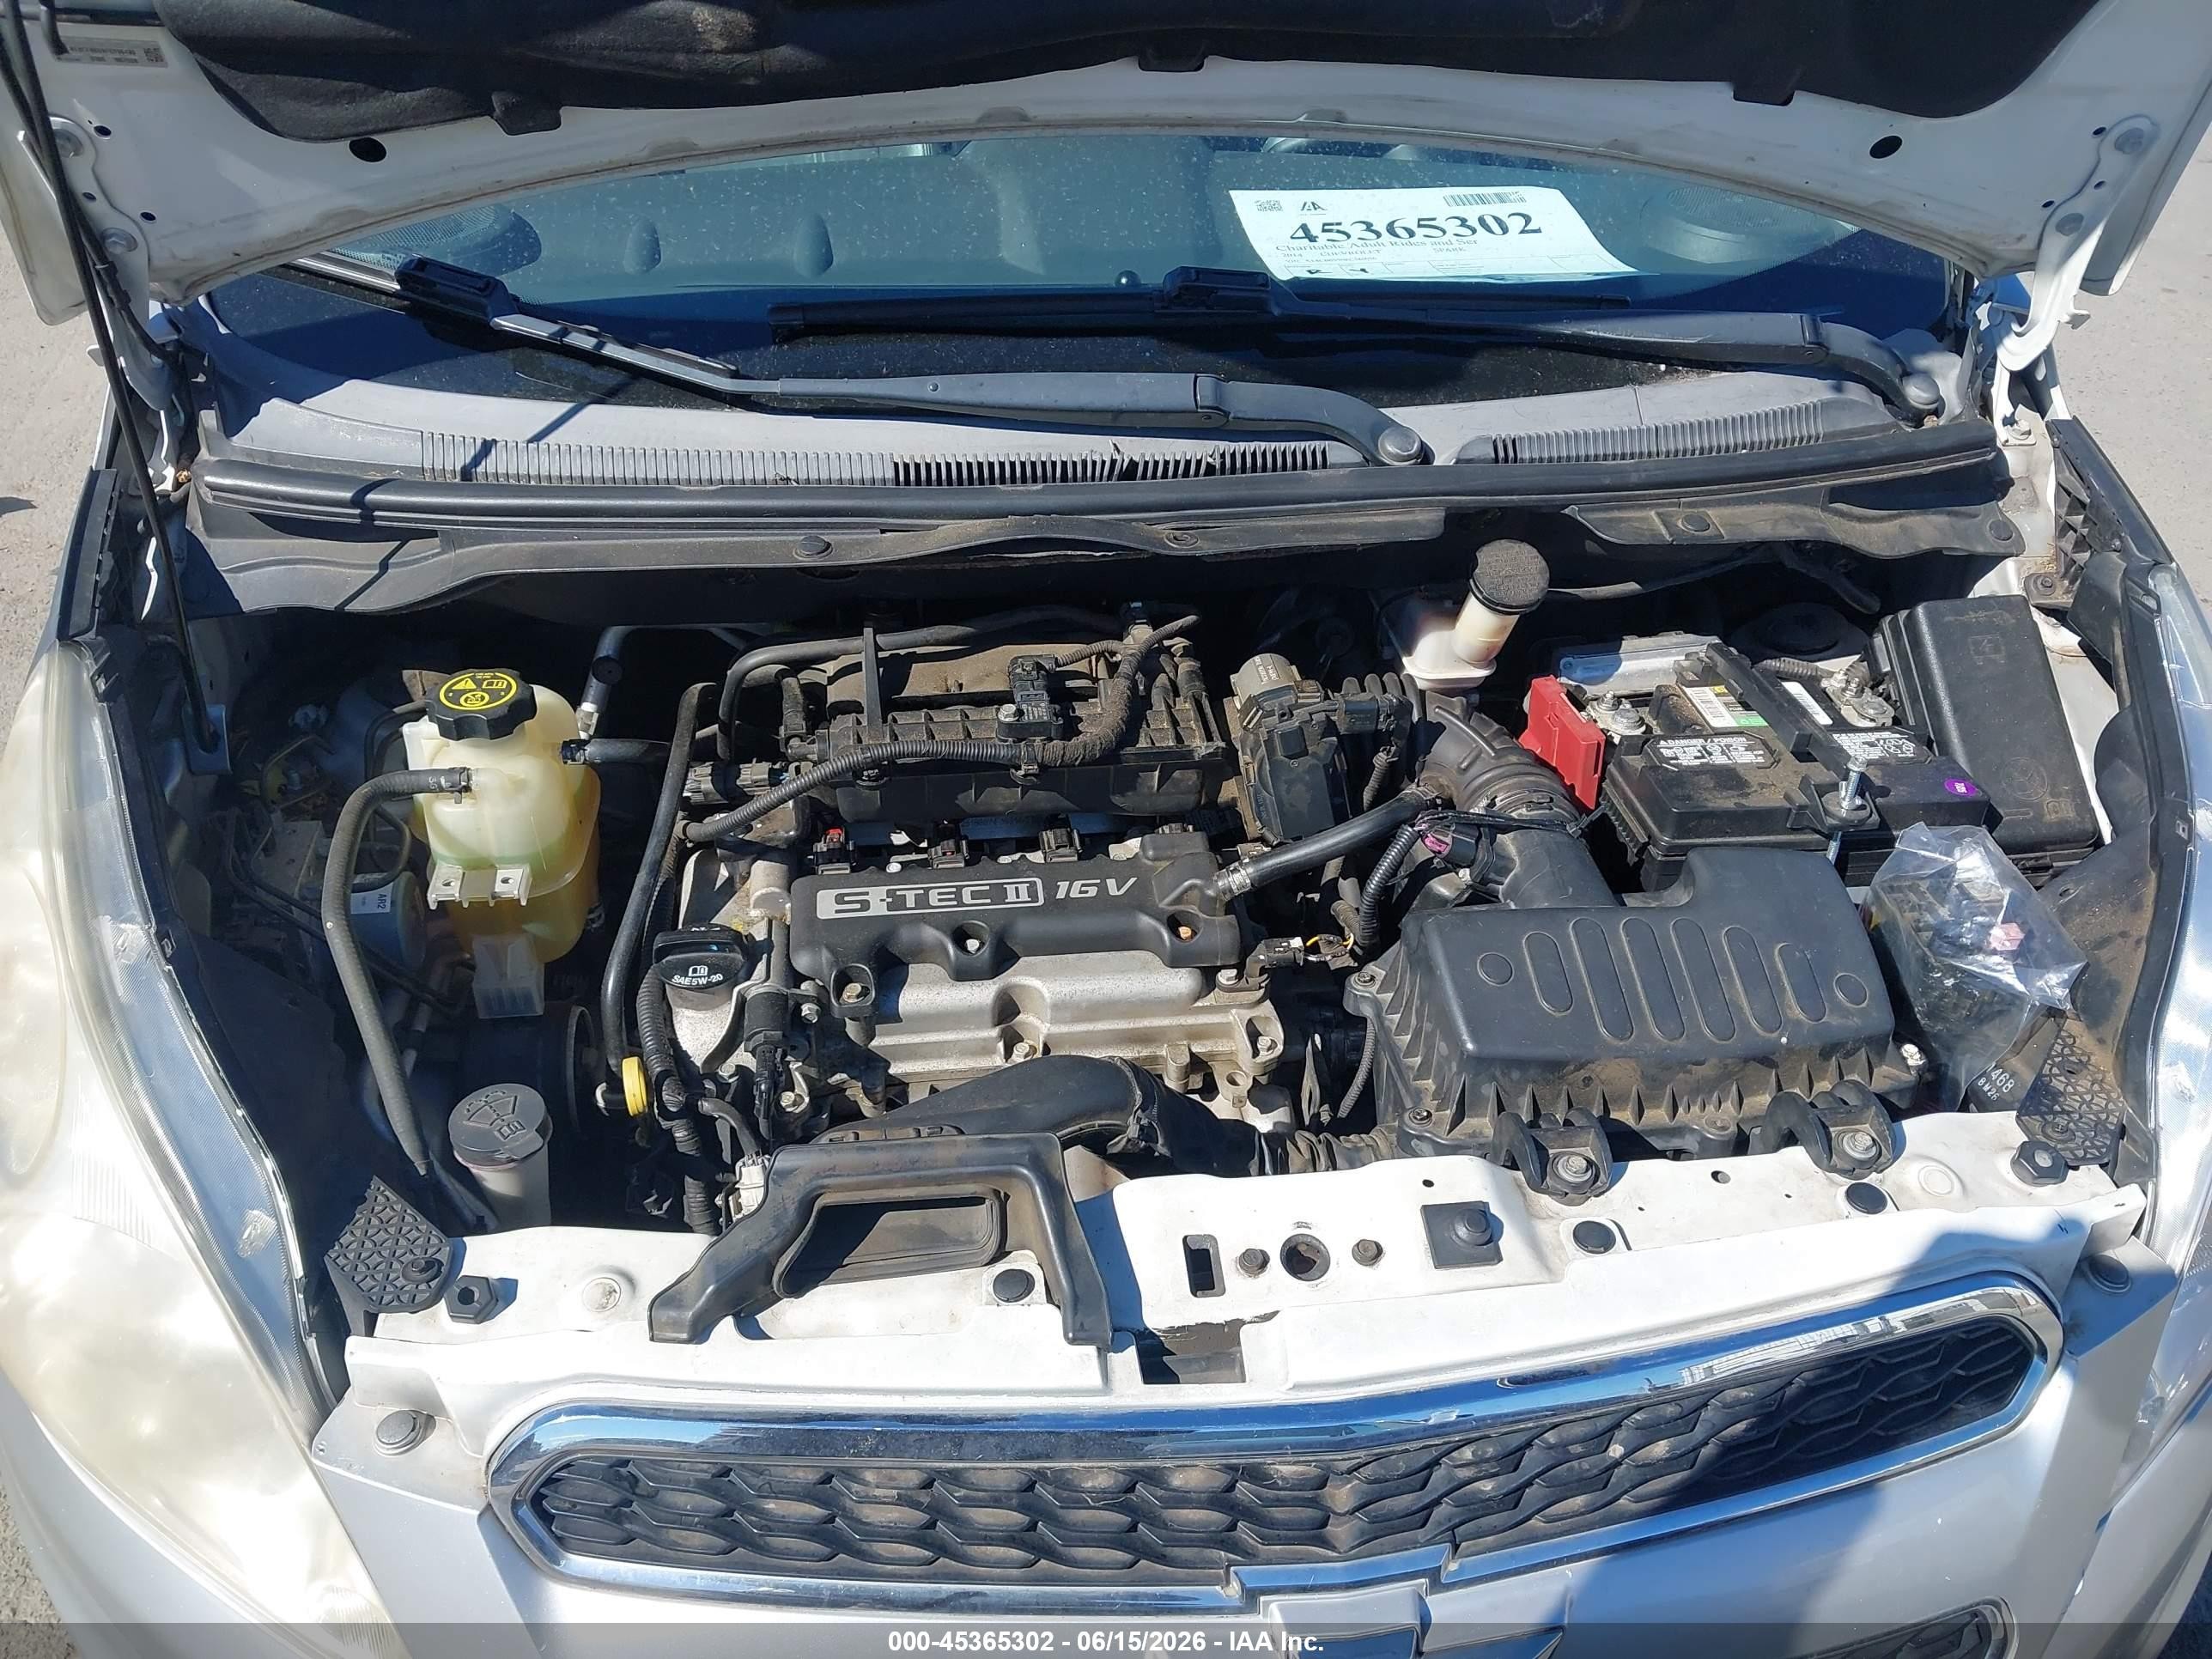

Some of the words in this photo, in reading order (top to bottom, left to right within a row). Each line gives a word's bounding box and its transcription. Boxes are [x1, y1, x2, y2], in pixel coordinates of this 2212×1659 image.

[1290, 212, 1542, 242] 45365302
[1276, 243, 1345, 252] Charitable
[1055, 878, 1138, 899] 16V
[377, 893, 387, 909] AR2
[672, 973, 724, 986] SAE5W-20
